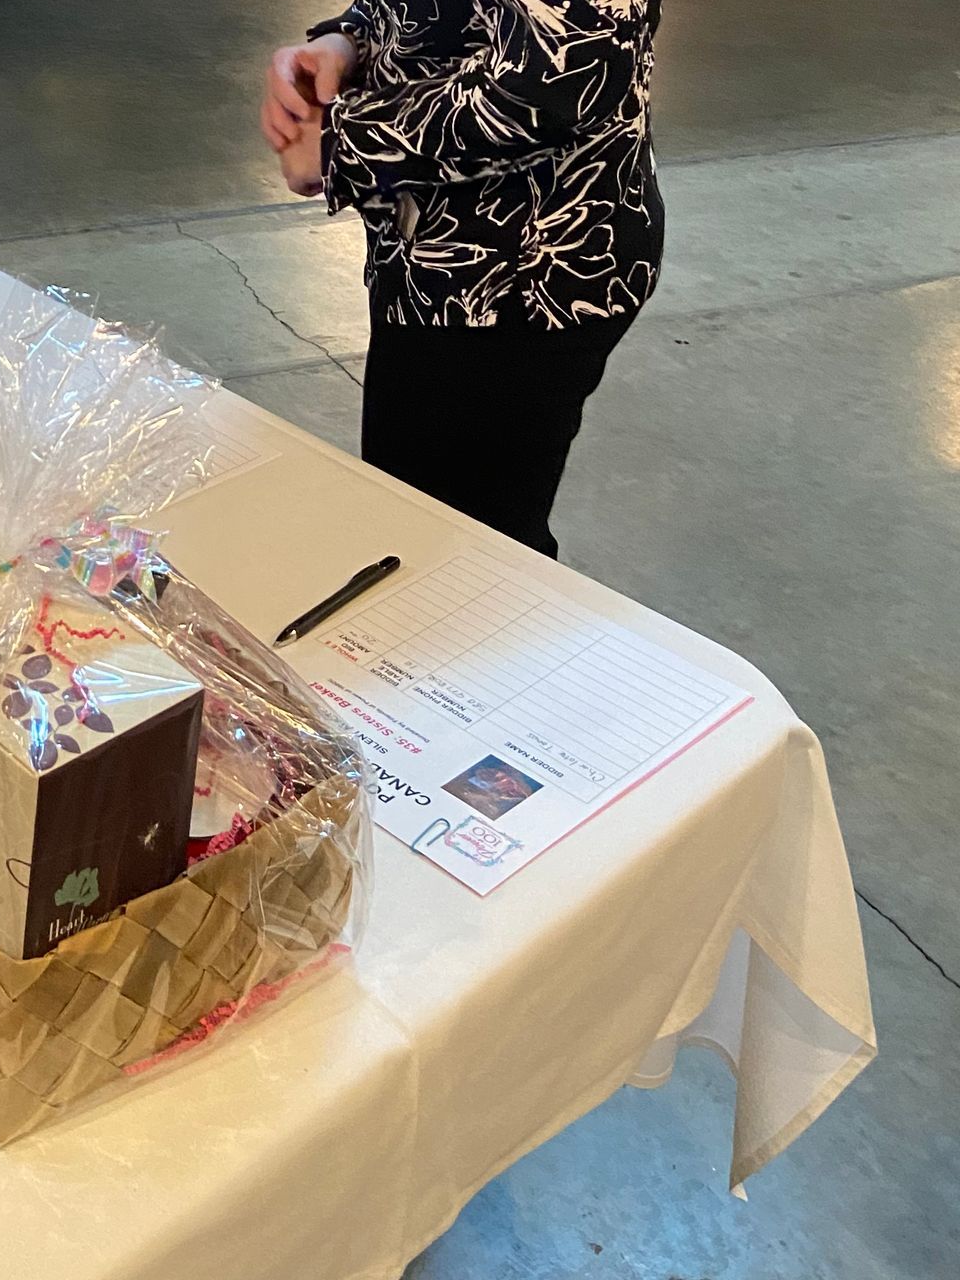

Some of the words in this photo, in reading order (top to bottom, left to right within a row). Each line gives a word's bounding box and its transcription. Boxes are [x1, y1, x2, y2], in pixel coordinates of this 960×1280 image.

[339, 634, 371, 653] AMOUNT
[340, 642, 355, 651] BID
[370, 668, 400, 686] BIDDER
[379, 666, 403, 681] TABLE
[382, 659, 414, 680] NUMBER
[309, 681, 347, 708] Basket
[413, 686, 441, 704] PHONE
[432, 690, 466, 711] NUMBER
[352, 707, 394, 736] Sisters
[375, 708, 397, 722] Friends
[441, 704, 472, 722] BIDDER
[406, 727, 431, 742] Donated
[395, 736, 422, 754] #35:
[505, 741, 530, 757] NAME
[531, 757, 564, 778] BIDDER
[473, 827, 502, 846] 100
[457, 832, 497, 860] Power
